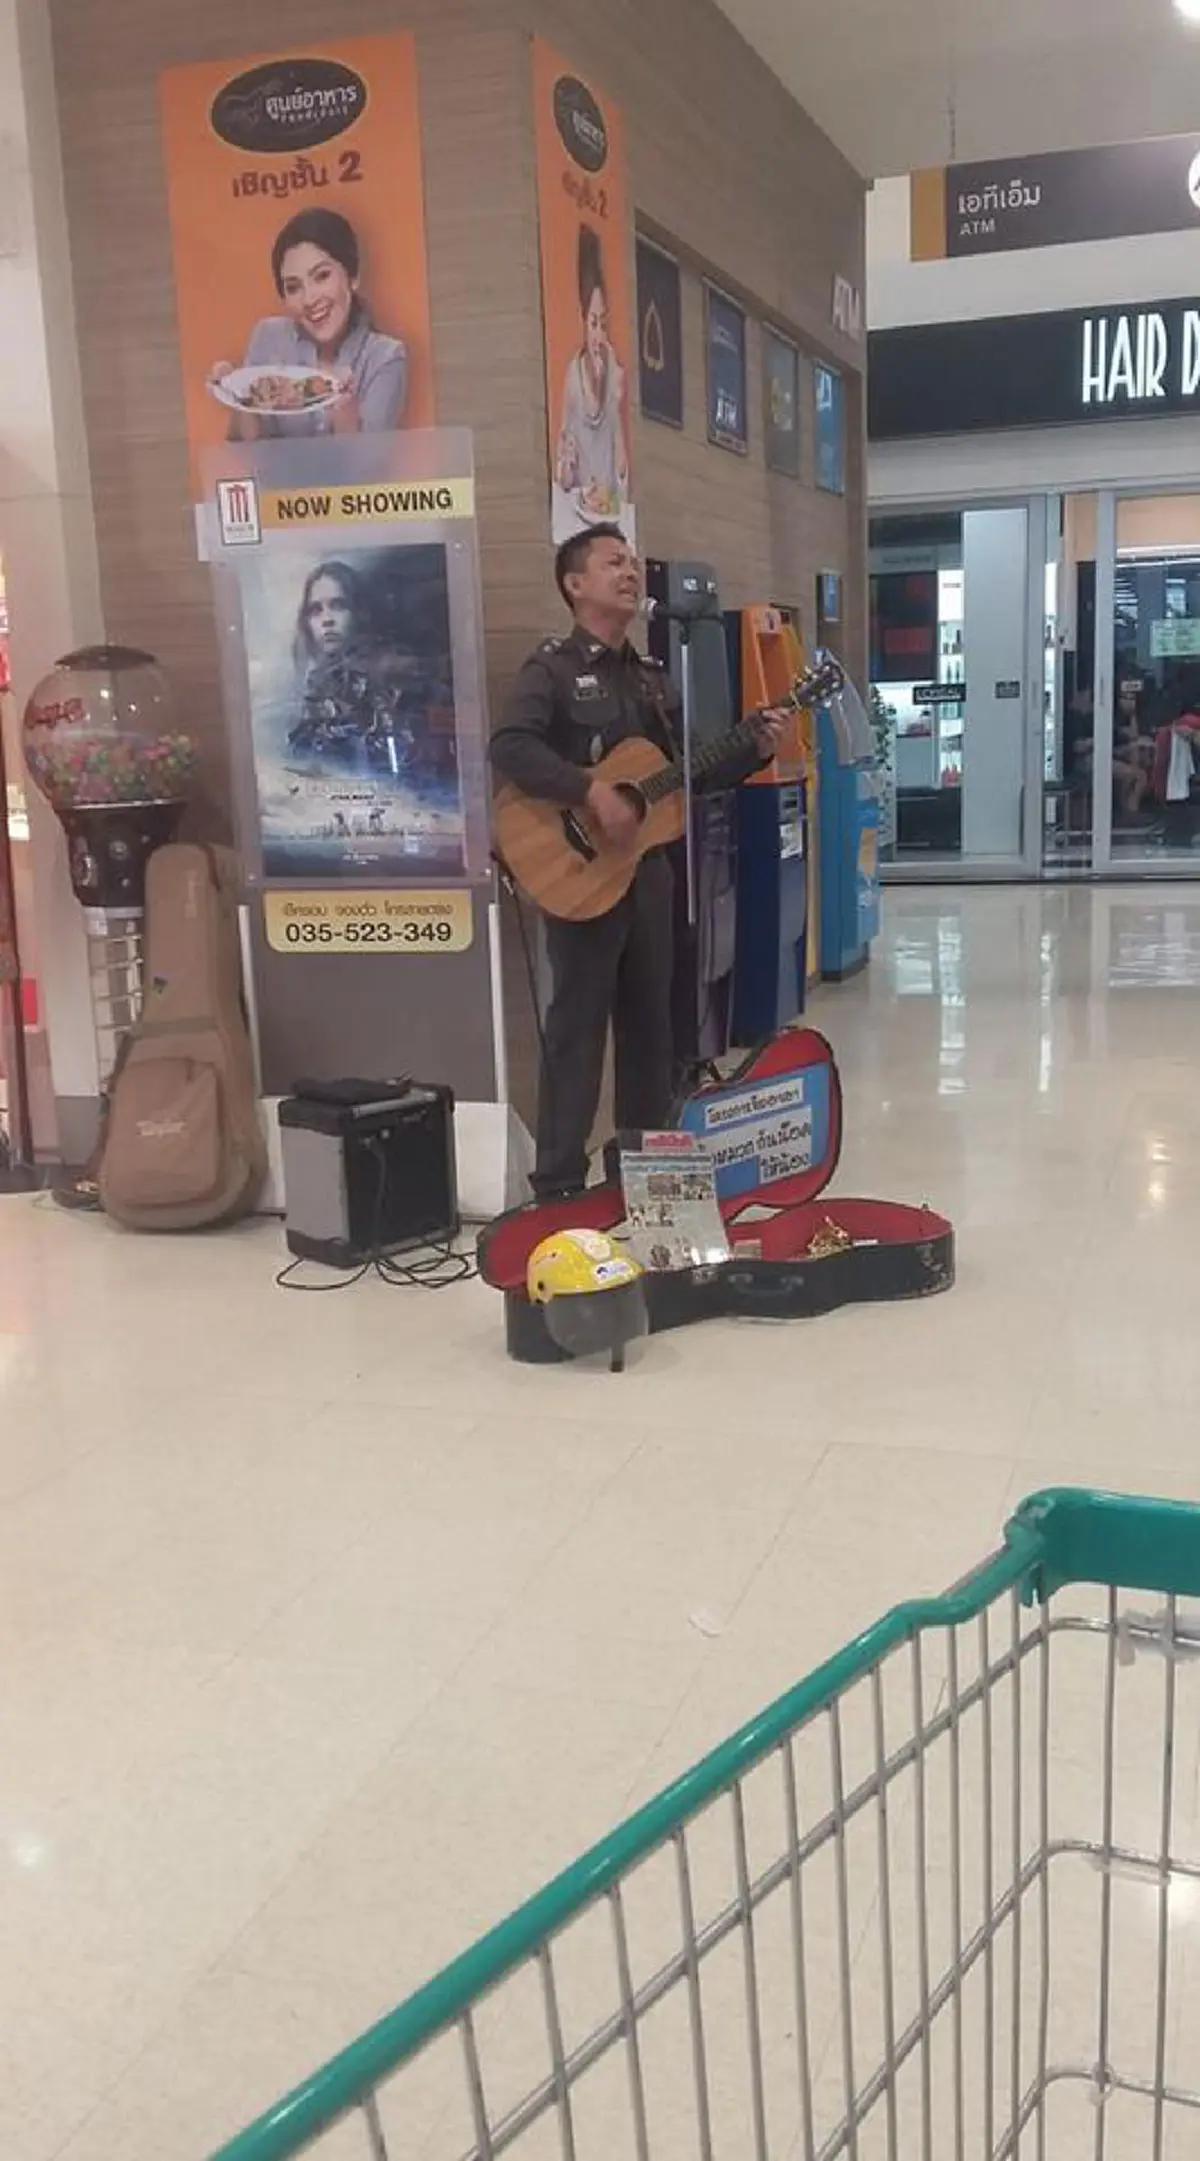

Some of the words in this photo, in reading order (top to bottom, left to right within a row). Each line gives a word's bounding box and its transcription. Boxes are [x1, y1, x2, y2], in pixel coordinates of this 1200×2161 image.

[265, 85, 357, 120] ศูนย์อาหาร
[232, 156, 329, 198] เชิญชั้น
[338, 150, 363, 182] 2
[958, 179, 1041, 214] เอทีเอ็ม
[959, 219, 996, 236] ATM
[832, 272, 861, 343] ATM
[1082, 313, 1168, 403] HAIR
[277, 496, 332, 520] NOW
[341, 488, 452, 515] SHOWING
[285, 922, 452, 942] 035-523-349
